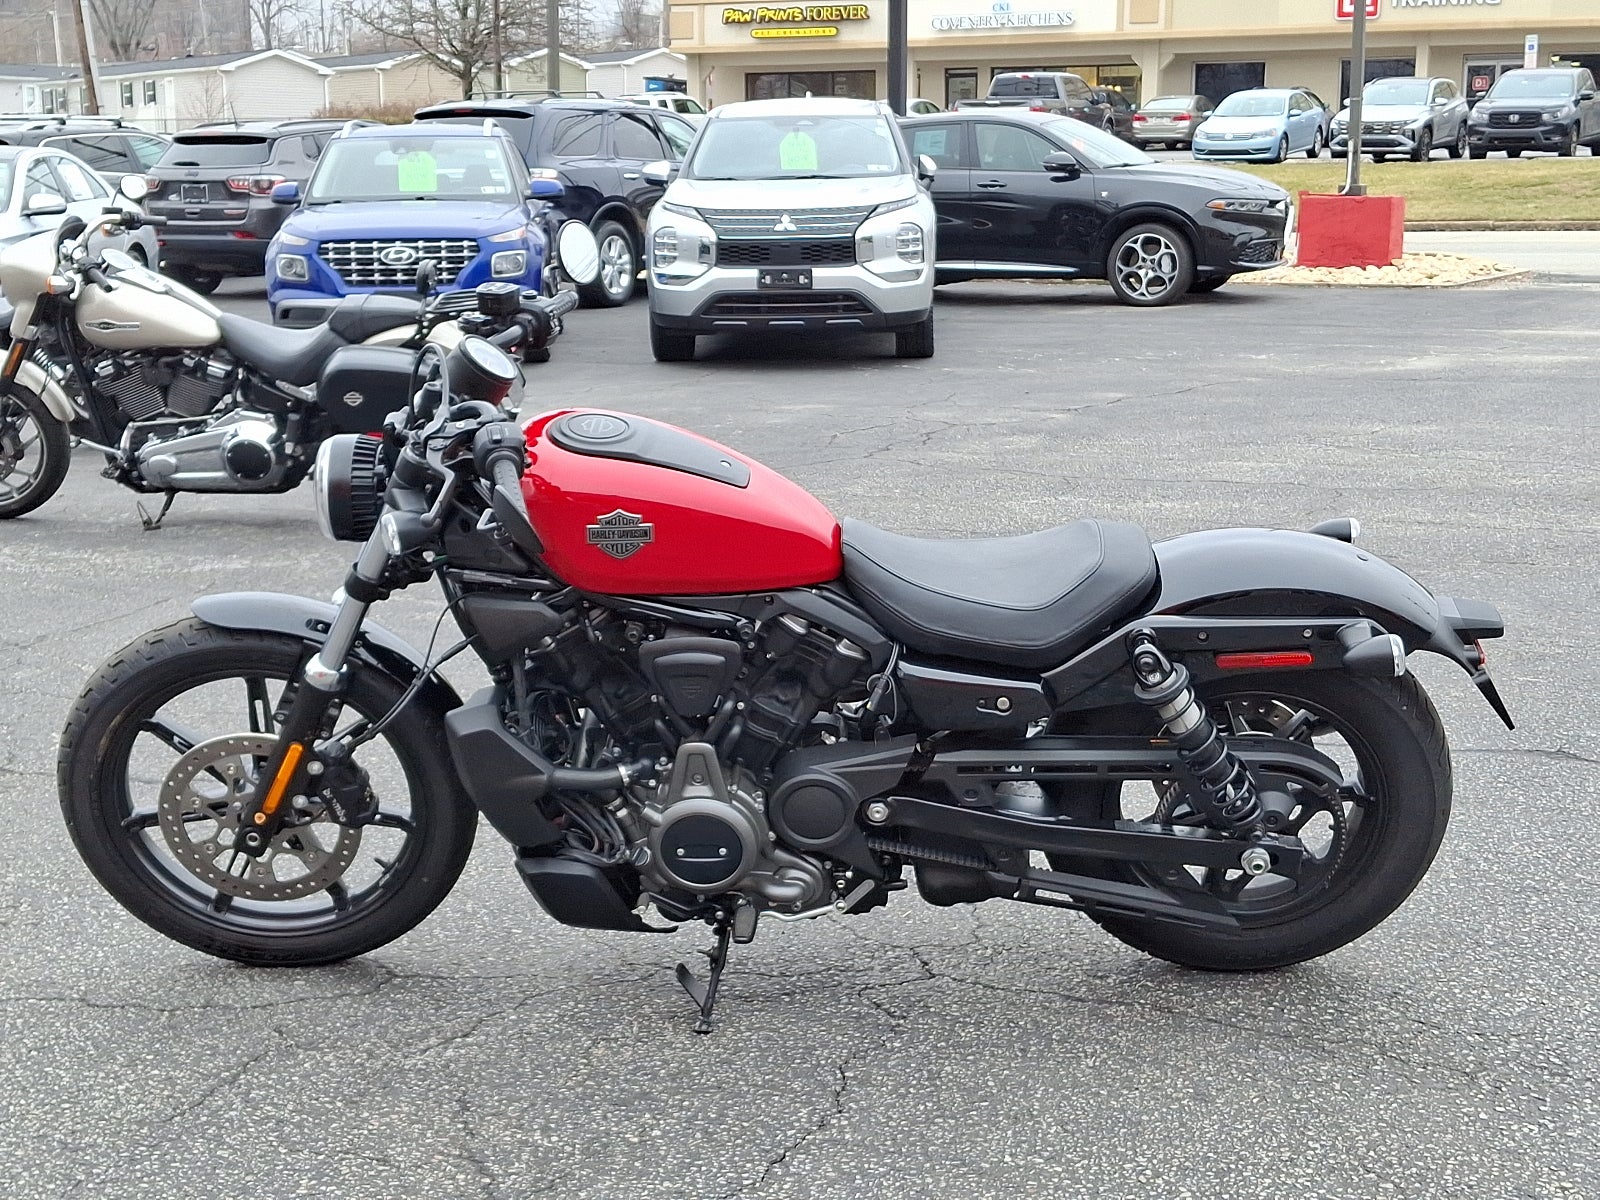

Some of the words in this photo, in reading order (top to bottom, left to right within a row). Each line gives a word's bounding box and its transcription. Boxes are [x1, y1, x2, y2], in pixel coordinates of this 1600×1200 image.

[722, 8, 752, 24] PAW
[756, 7, 804, 23] PRINTS
[805, 5, 869, 22] FOREVER
[931, 15, 1001, 29] COVENTRY
[1006, 12, 1073, 26] KITCHENS
[604, 516, 635, 526] MOTOR
[591, 529, 648, 539] HARLEY-DAVIDSON
[605, 543, 637, 554] CYCLES
[323, 787, 346, 822] brmbo
